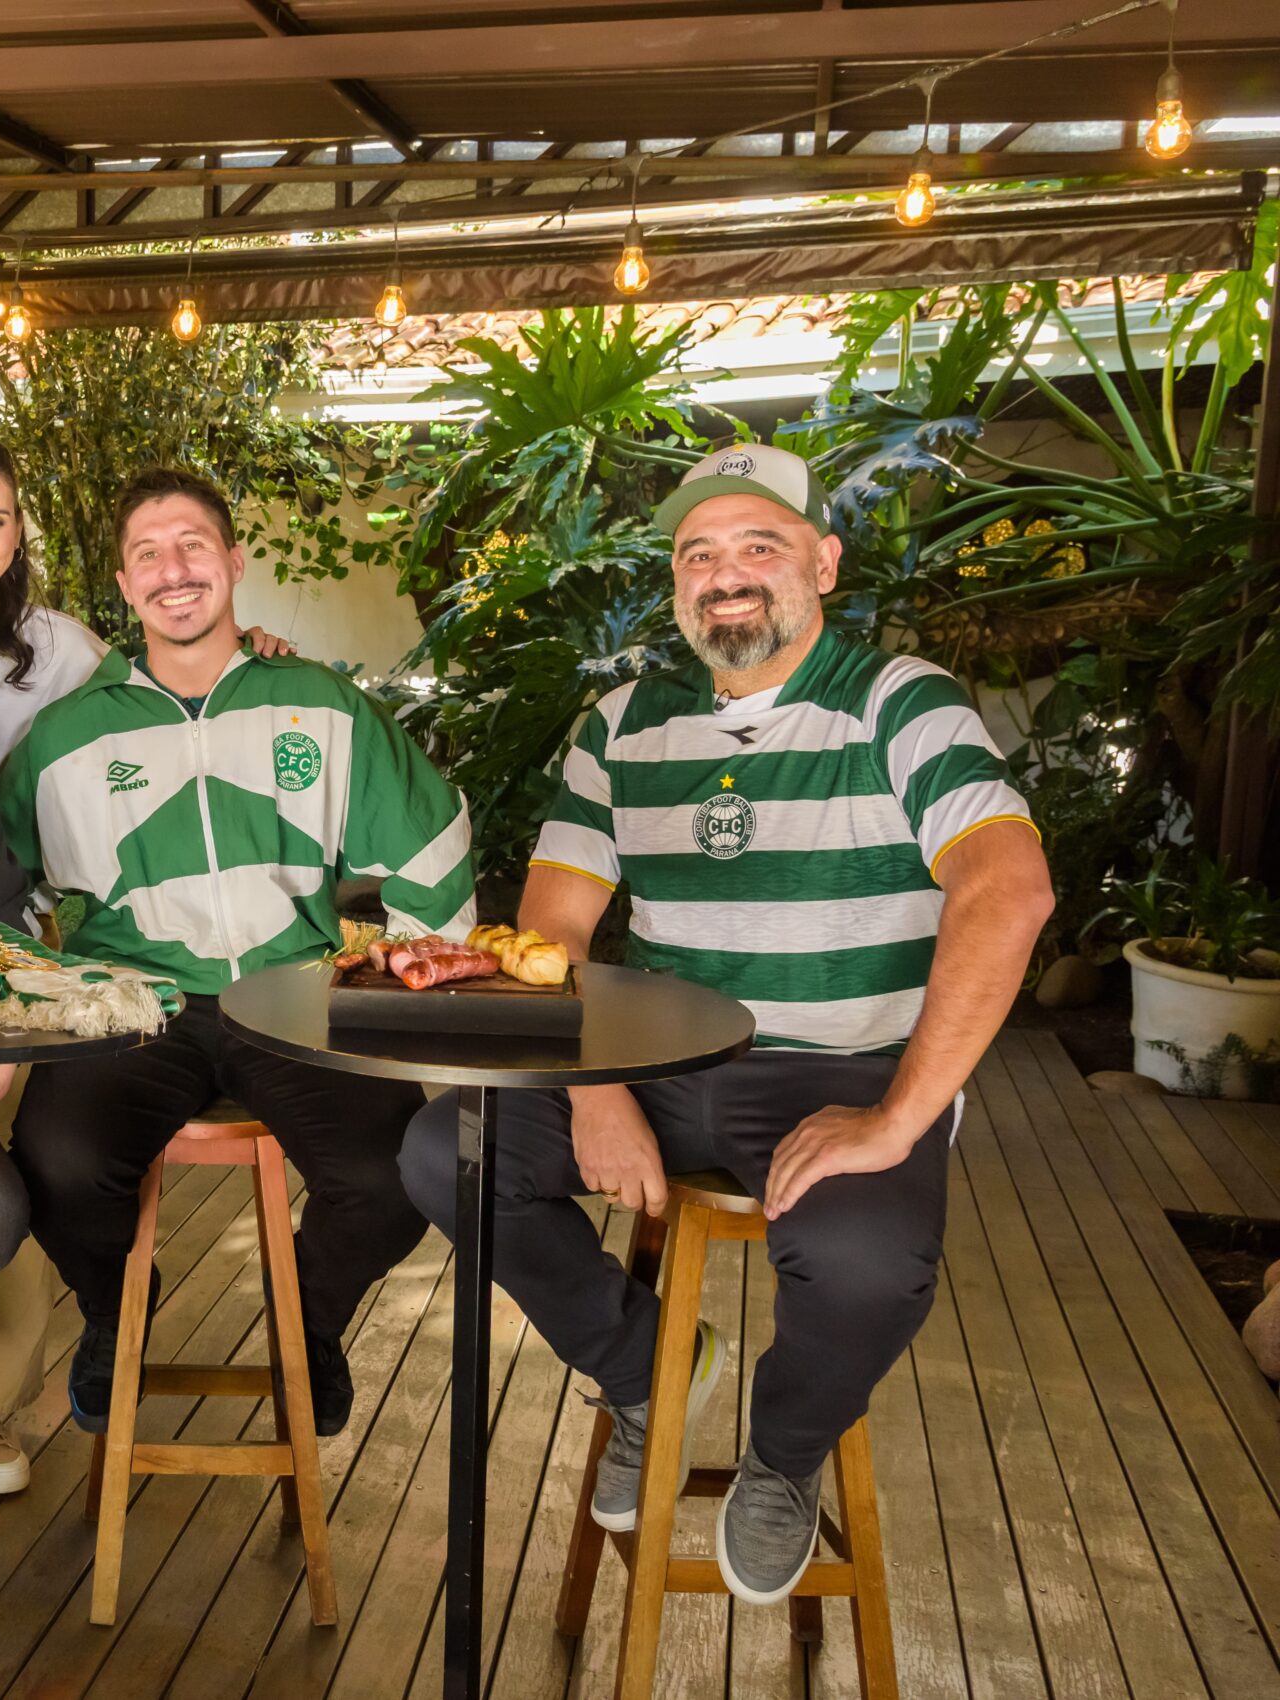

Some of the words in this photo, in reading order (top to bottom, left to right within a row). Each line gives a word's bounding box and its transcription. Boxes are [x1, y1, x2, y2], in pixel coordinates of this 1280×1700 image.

[285, 733, 305, 742] FOOT
[305, 738, 319, 756] BALL
[277, 752, 312, 773] CFC
[311, 758, 320, 778] CLUB
[110, 779, 149, 795] MBRO
[695, 803, 713, 838] CORITIBA
[712, 795, 733, 805] FOOT
[733, 797, 749, 814] BALL
[745, 813, 754, 835] CLUB
[708, 818, 742, 834] CFC
